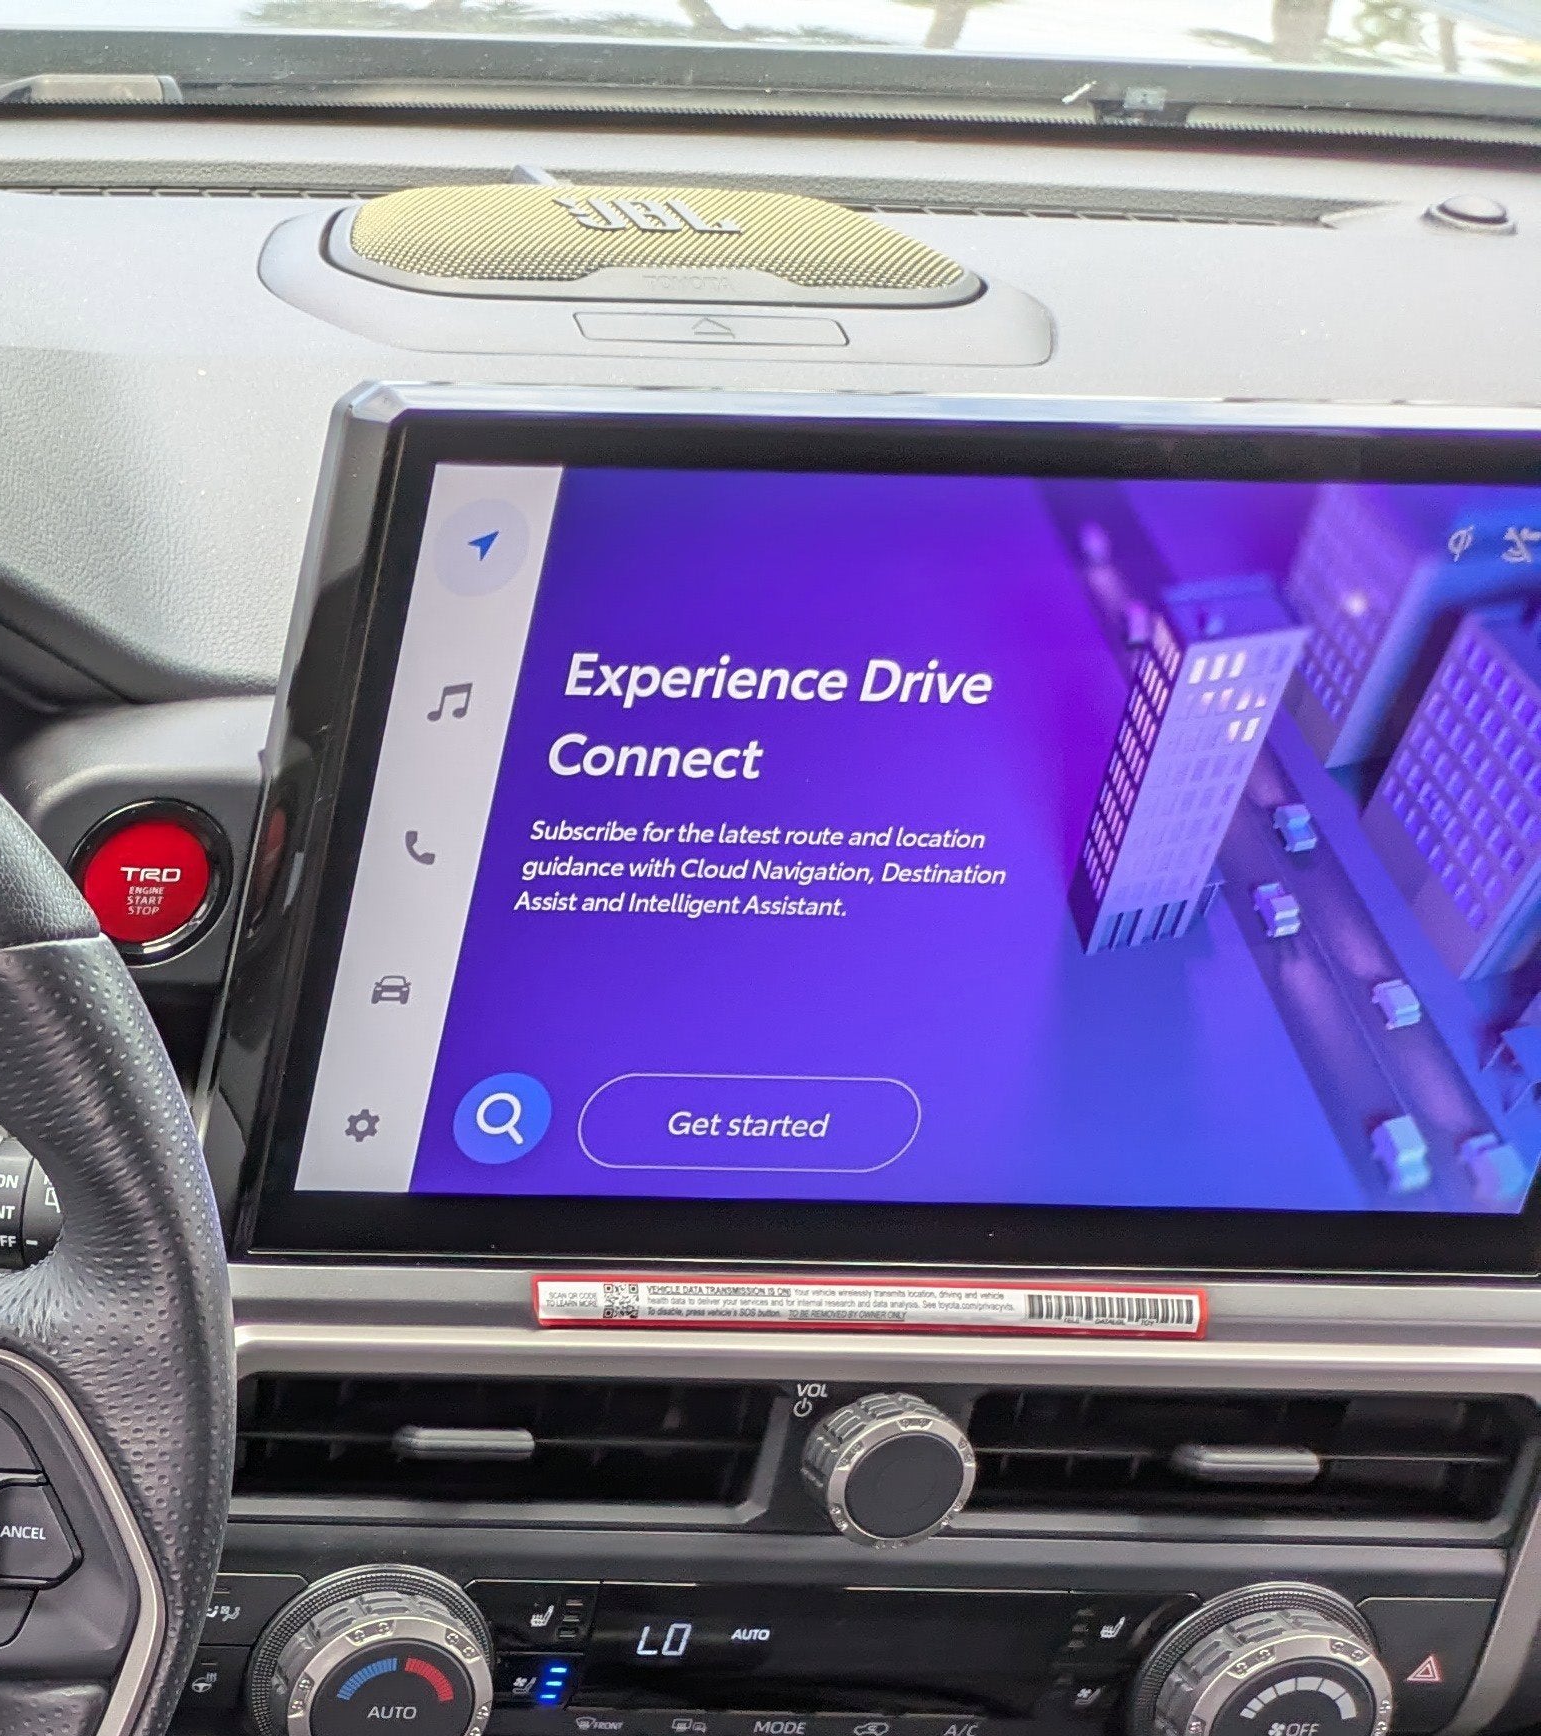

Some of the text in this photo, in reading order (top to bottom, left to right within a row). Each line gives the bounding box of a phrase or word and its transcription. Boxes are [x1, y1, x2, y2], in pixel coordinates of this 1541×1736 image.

[552, 198, 743, 232] JBL
[564, 652, 994, 708] Experience Drive
[548, 732, 764, 780] Connect
[530, 819, 986, 849] Subscribe for the latest route and location
[120, 866, 182, 883] TRD
[522, 855, 1006, 886] guidance with Cloud Navigation, Destination
[128, 886, 165, 895] ENGINE
[126, 896, 165, 905] START
[513, 890, 847, 919] Assist and Intelligent Assistant.
[127, 906, 160, 916] STOP
[667, 1110, 831, 1138] Get started
[548, 1291, 597, 1301] SCAN CODE
[647, 1285, 680, 1295] VEHICLE
[683, 1286, 703, 1295] DATA
[705, 1286, 766, 1296] TRANSMISSION
[794, 1289, 809, 1297] Your
[812, 1289, 836, 1297] vehicle
[838, 1289, 872, 1299] wirelessly
[874, 1289, 906, 1298] transmits
[939, 1290, 962, 1300] driving
[964, 1291, 978, 1299] and
[980, 1291, 1004, 1300] vehicle
[556, 1299, 598, 1308] LEARN MORE
[647, 1296, 669, 1305] health
[671, 1297, 686, 1305] data
[697, 1297, 720, 1306] deliver
[722, 1298, 738, 1307] your
[740, 1298, 767, 1306] services
[770, 1298, 783, 1306] and
[797, 1298, 822, 1307] internal
[825, 1299, 855, 1308] research
[857, 1299, 871, 1308] and
[872, 1299, 888, 1308] data
[922, 1300, 936, 1309] See
[685, 1309, 706, 1318] press
[739, 1308, 756, 1317] SOS
[810, 1310, 847, 1319] REMOVED
[859, 1311, 888, 1319] OWNER
[888, 1311, 908, 1320] ONLY
[796, 1383, 829, 1398] VOL
[731, 1627, 771, 1642] AUTO
[367, 1705, 418, 1720] AUTO
[592, 1719, 624, 1731] FRONT
[753, 1720, 806, 1736] MODE
